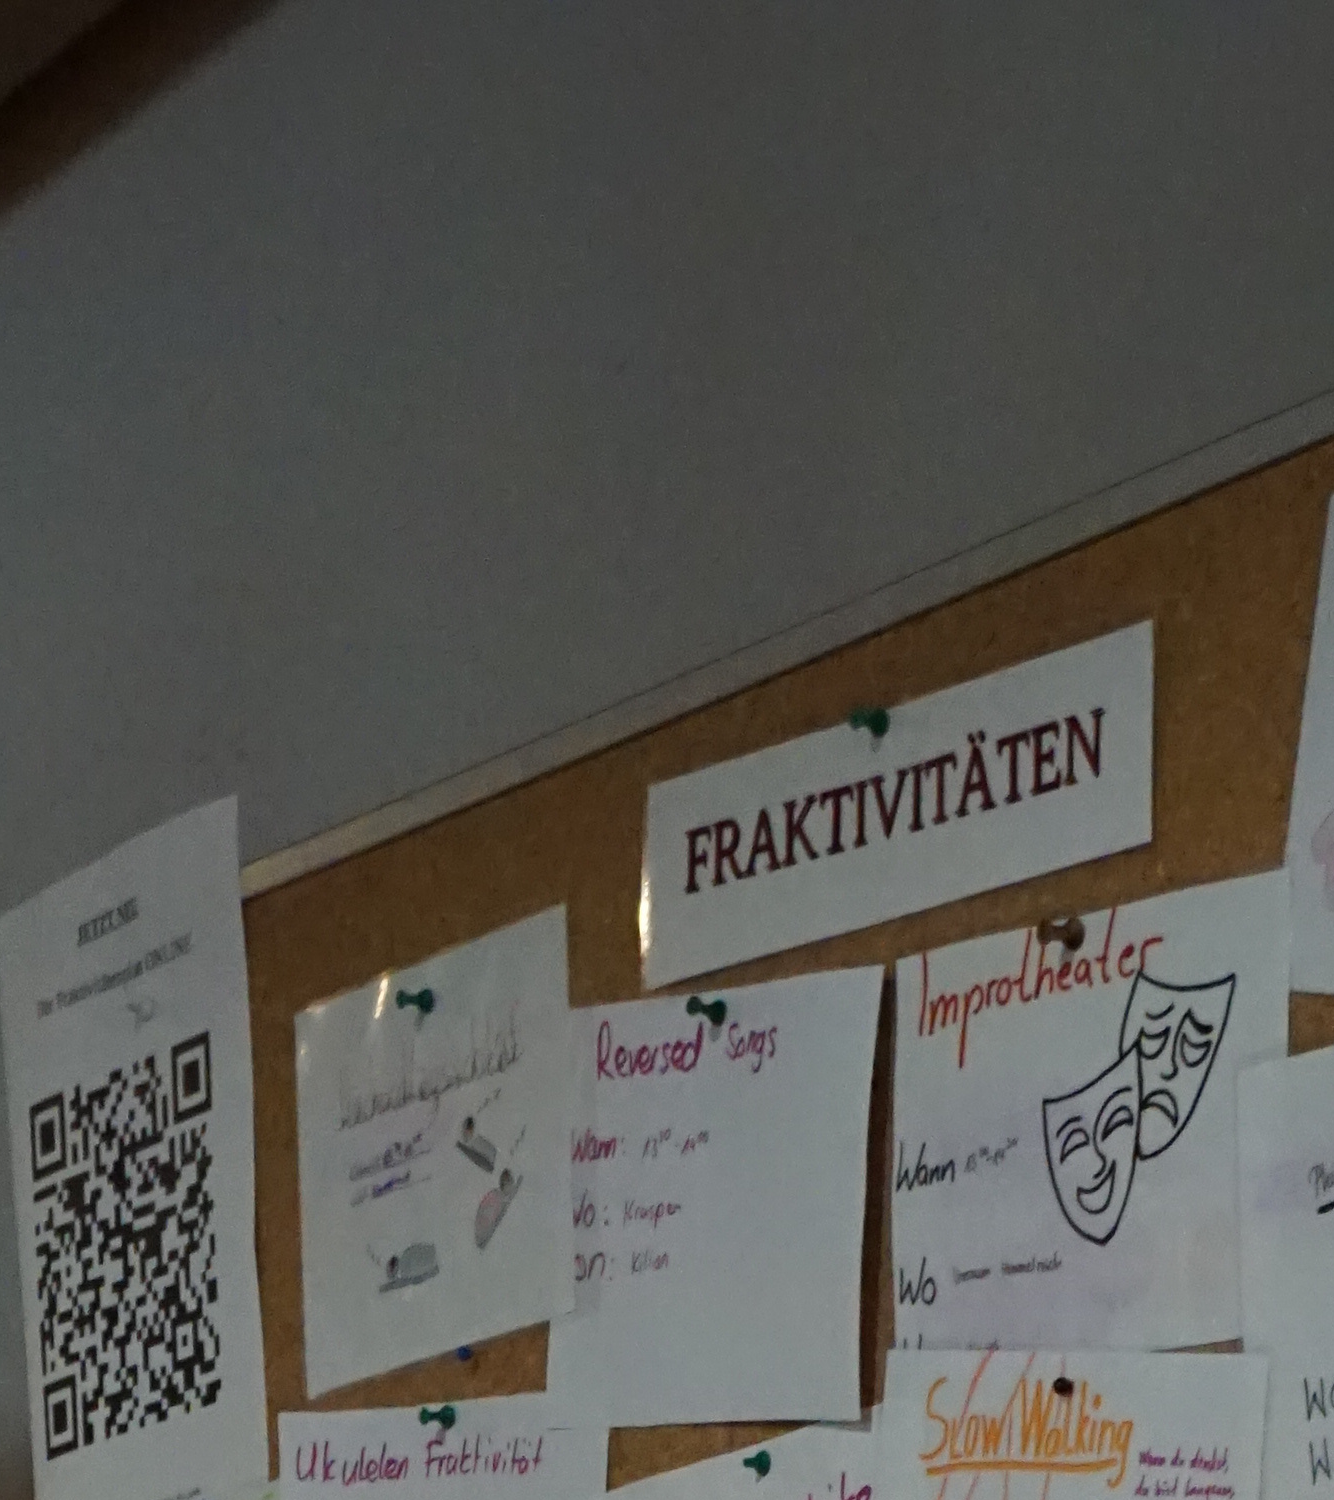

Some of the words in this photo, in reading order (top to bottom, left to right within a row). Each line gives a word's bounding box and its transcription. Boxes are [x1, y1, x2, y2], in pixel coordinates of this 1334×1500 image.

[683, 708, 1105, 895] FRAKTIVITÄTEN
[919, 907, 1164, 1069] Improtheater
[597, 1019, 705, 1082] Reversed
[724, 1020, 778, 1075] Songs
[896, 1140, 956, 1193] Wann
[898, 1255, 937, 1306] Wo
[296, 1439, 409, 1487] Ukulelen
